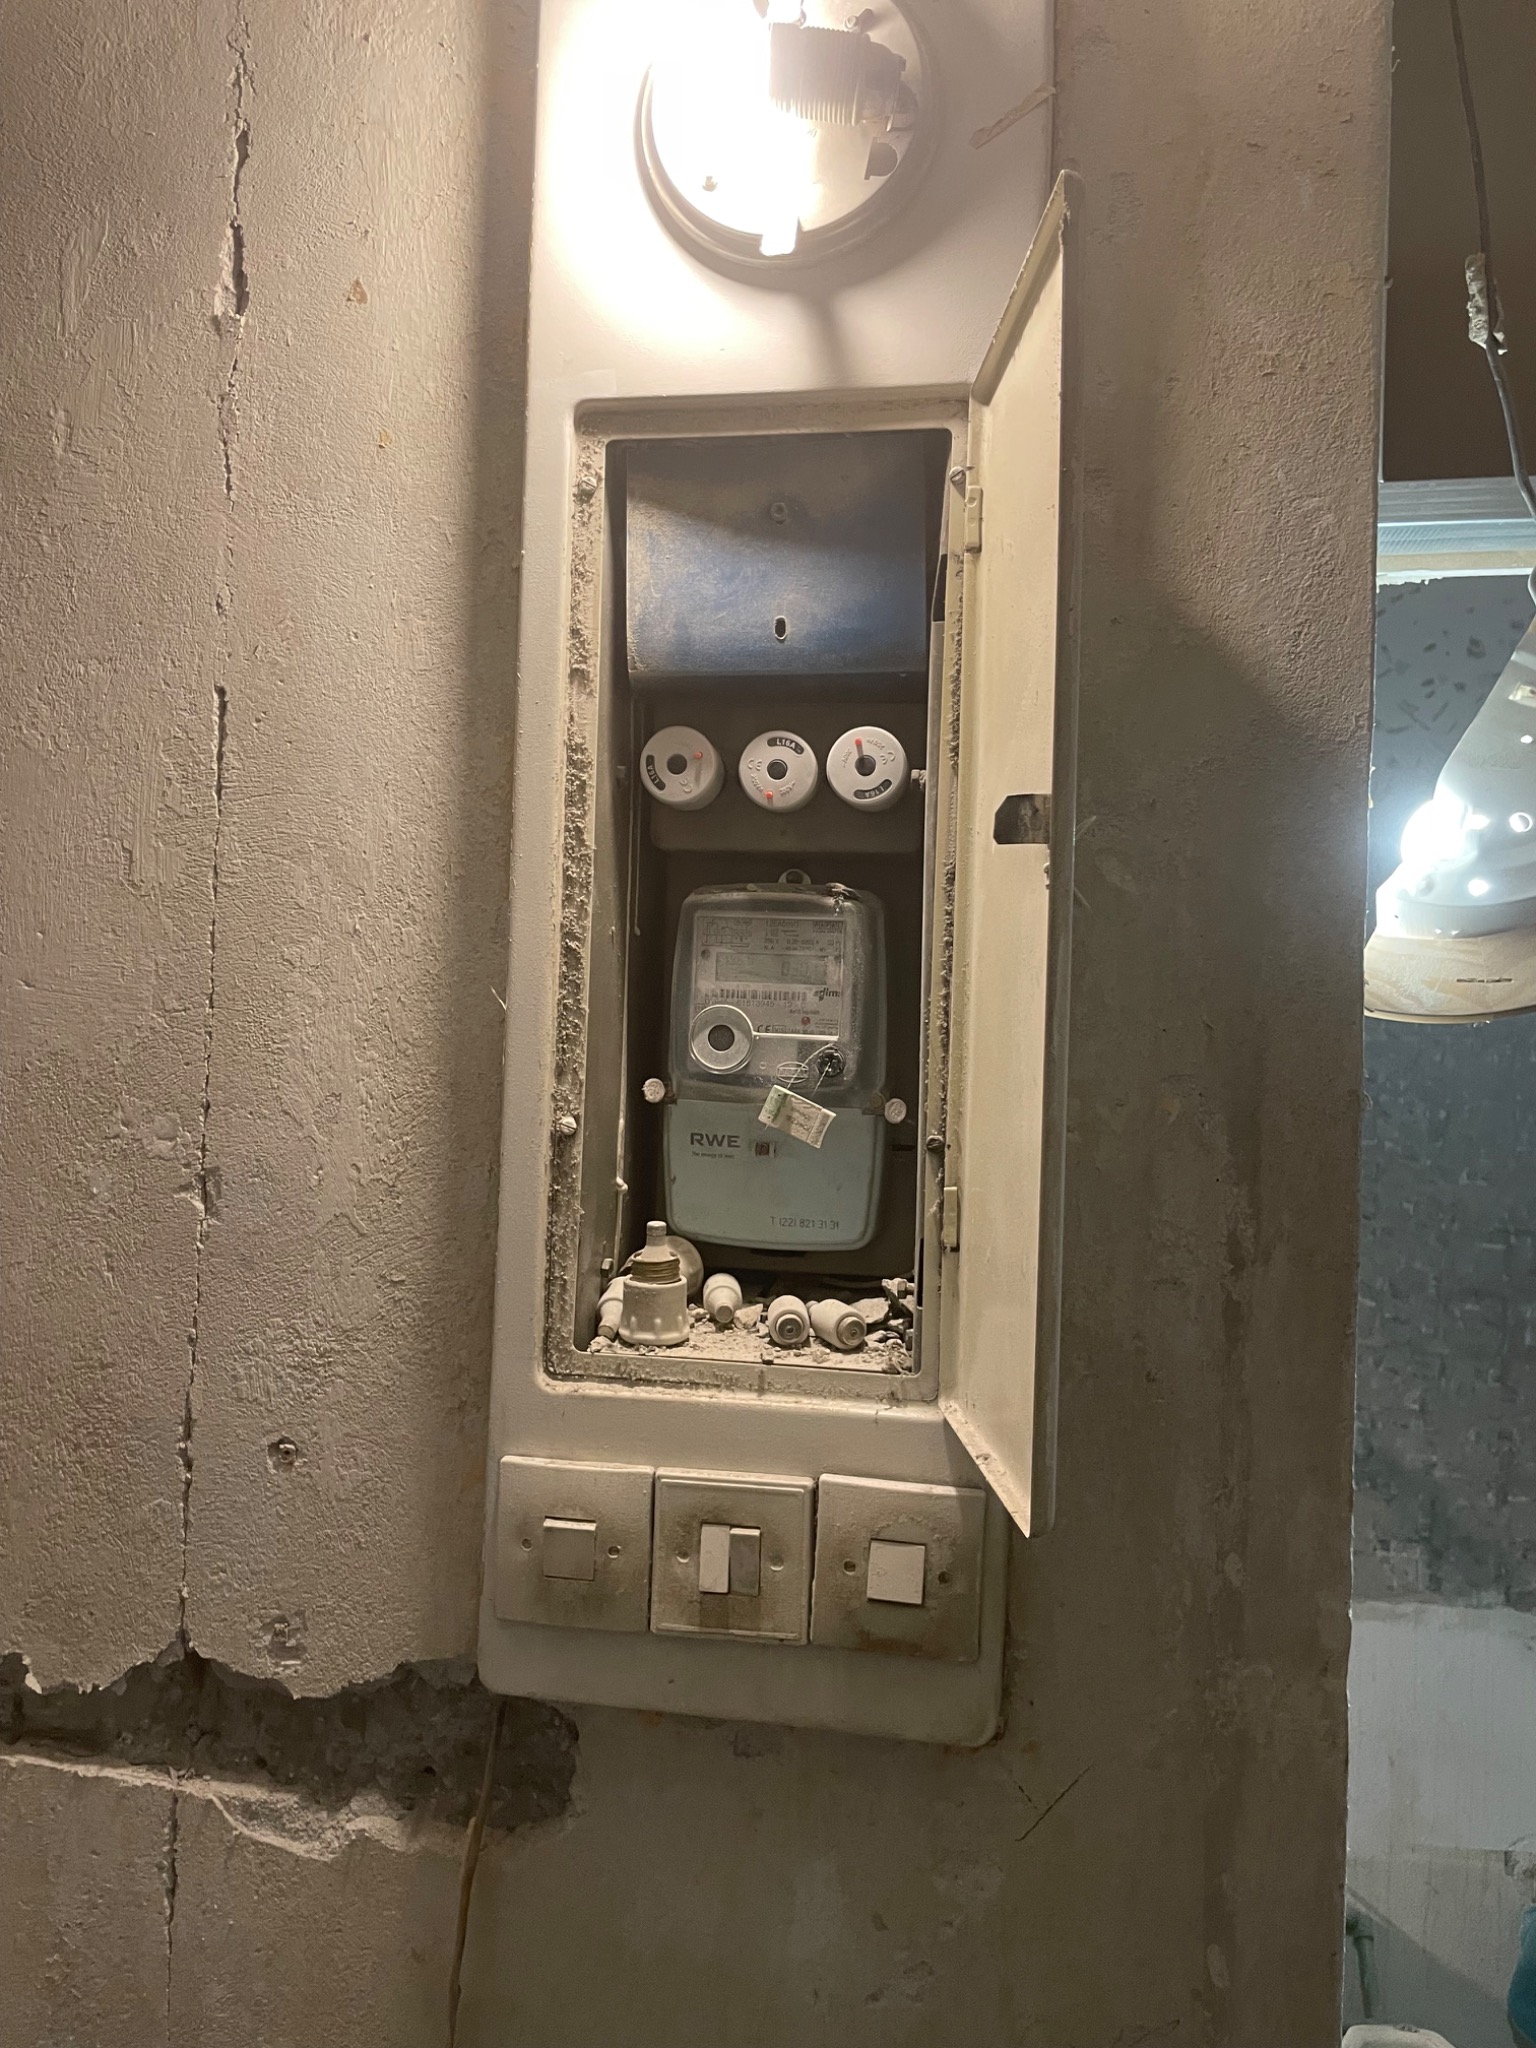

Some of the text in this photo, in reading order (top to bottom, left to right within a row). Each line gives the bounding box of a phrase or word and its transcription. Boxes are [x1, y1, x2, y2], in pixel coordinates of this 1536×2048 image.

[776, 738, 797, 750] L16A
[690, 1132, 741, 1148] RWE
[770, 1216, 776, 1225] T
[799, 1218, 815, 1228] 821
[818, 1219, 827, 1229] 31
[829, 1220, 839, 1230] 31
